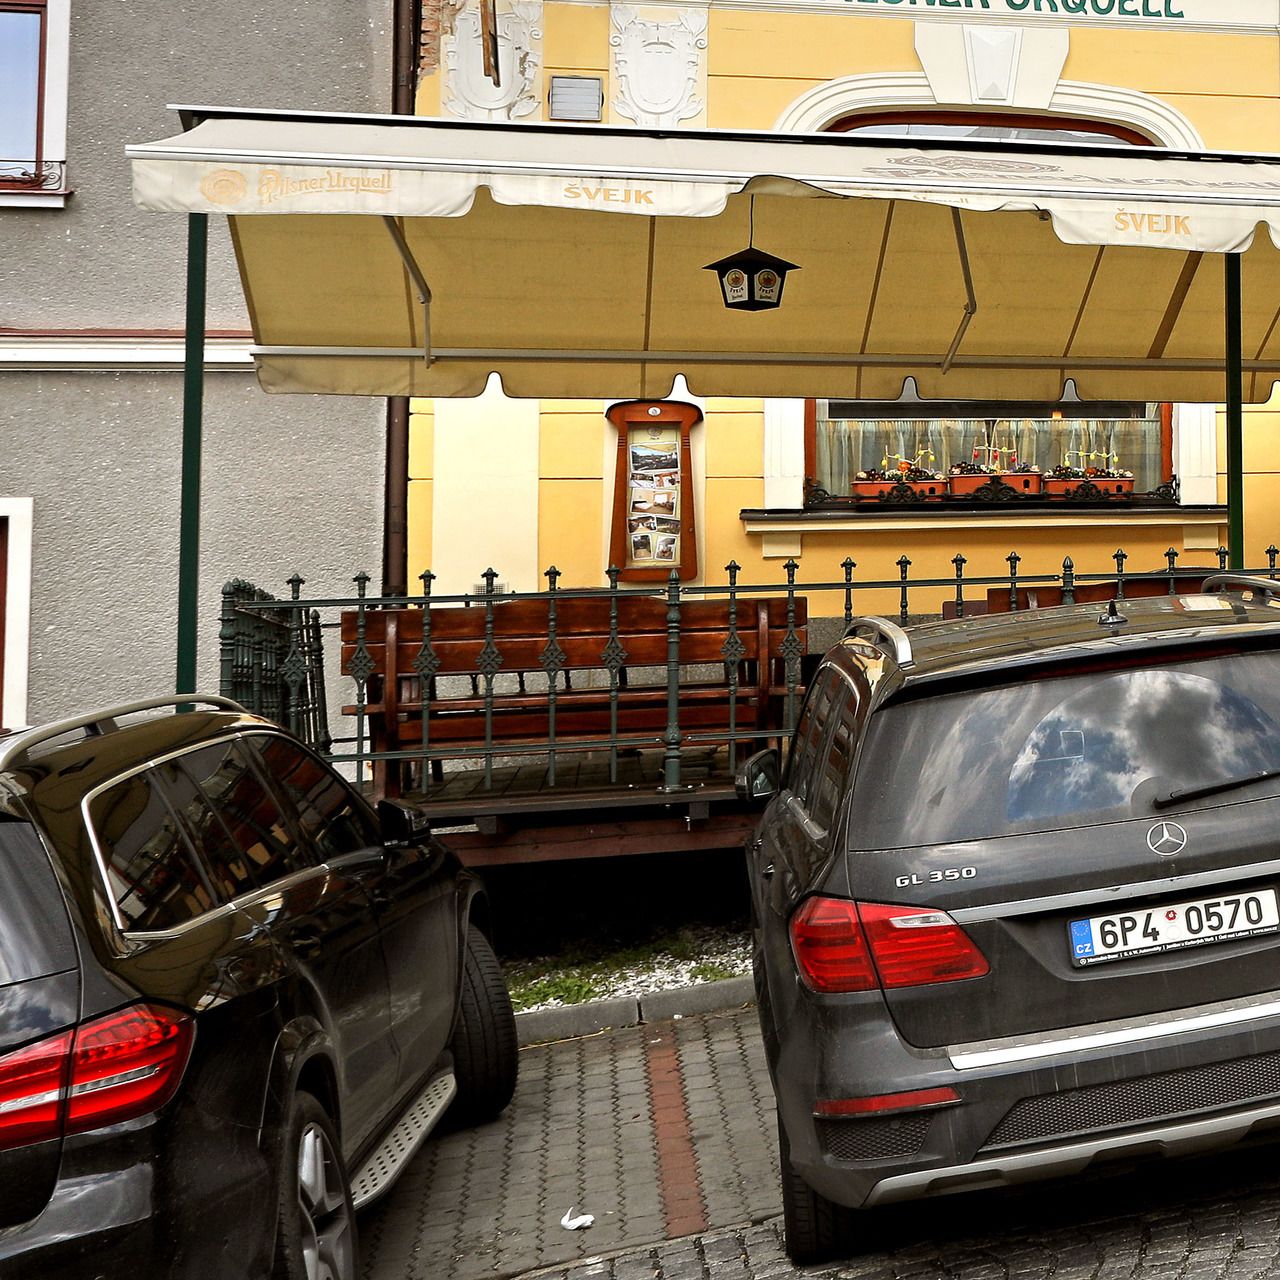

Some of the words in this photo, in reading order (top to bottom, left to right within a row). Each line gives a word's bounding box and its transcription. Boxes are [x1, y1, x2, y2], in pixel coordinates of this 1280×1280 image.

[563, 183, 654, 205] ŠVEJK
[1114, 207, 1193, 235] ŠVEJK
[895, 873, 924, 888] GL
[928, 866, 977, 883] 350
[1099, 911, 1160, 949] 6P4
[1184, 896, 1263, 935] 0570
[1076, 943, 1092, 954] CZ
